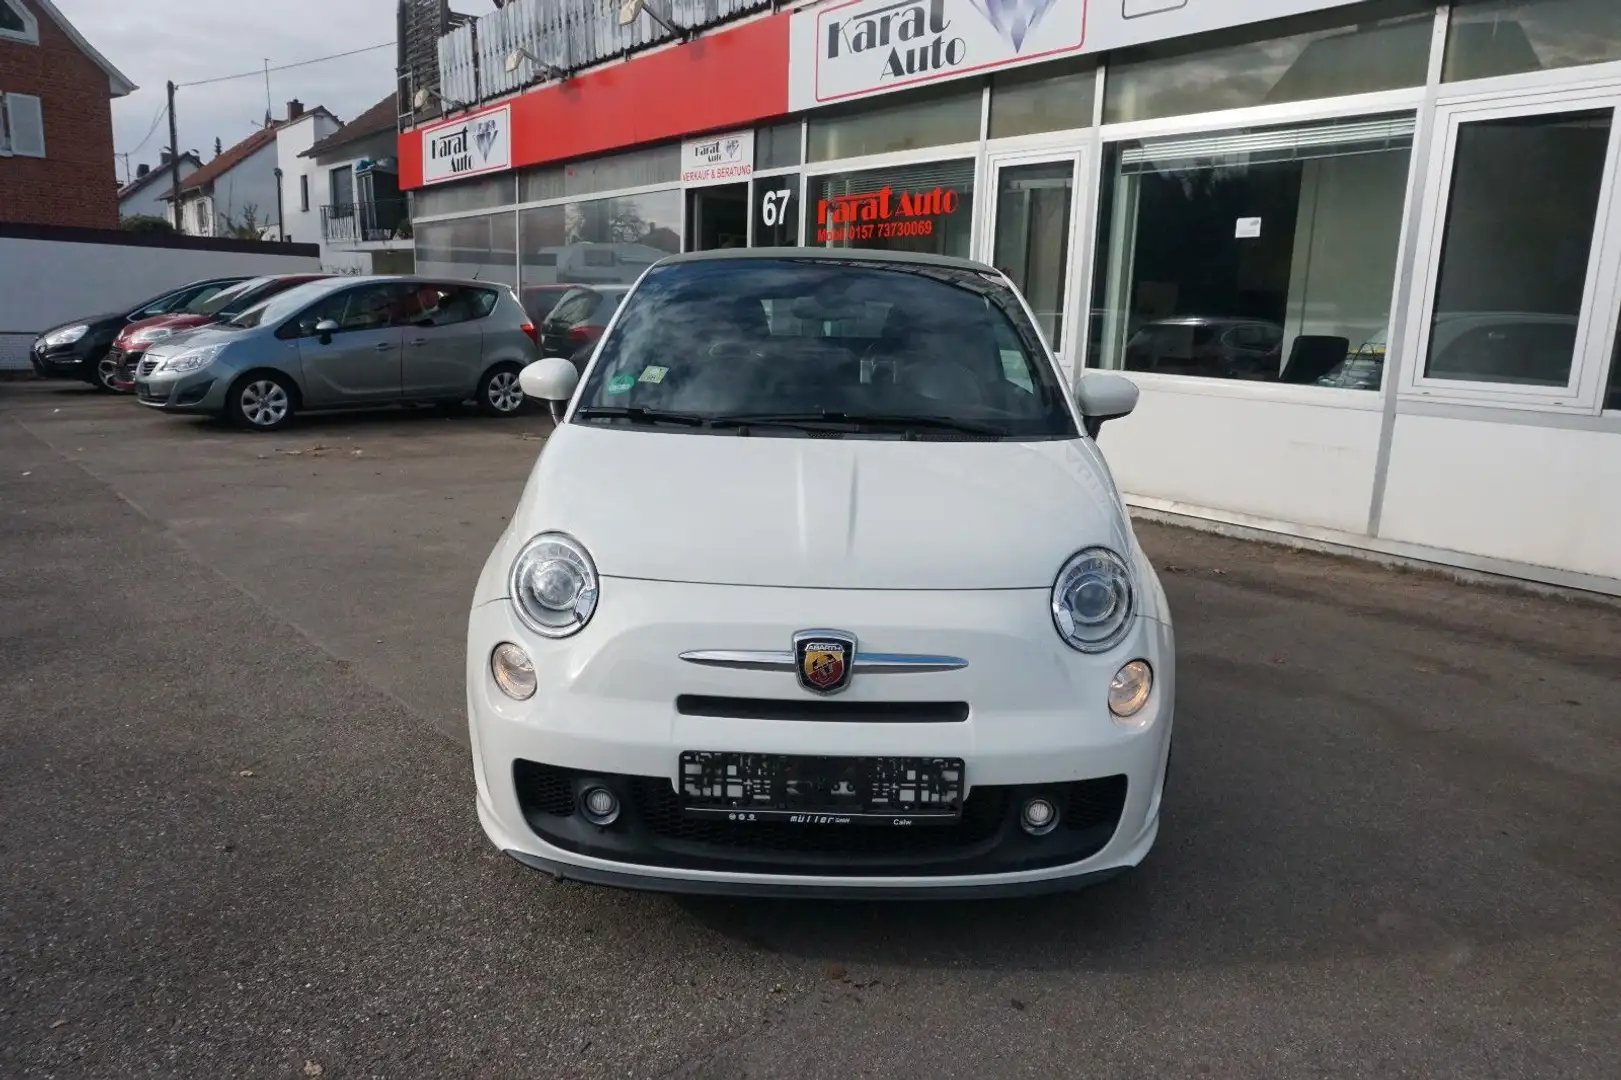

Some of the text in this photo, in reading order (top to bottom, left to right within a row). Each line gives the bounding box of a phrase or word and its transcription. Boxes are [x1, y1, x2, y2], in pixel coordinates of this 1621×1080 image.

[827, 0, 952, 59] Karat
[879, 36, 967, 81] Auto
[449, 153, 474, 173] Auto
[682, 168, 710, 182] VERKAUF
[716, 164, 752, 179] BERATUNG
[762, 189, 791, 227] 67
[895, 185, 960, 217] Auto
[849, 224, 875, 241] 0157
[878, 220, 933, 239] 73730069
